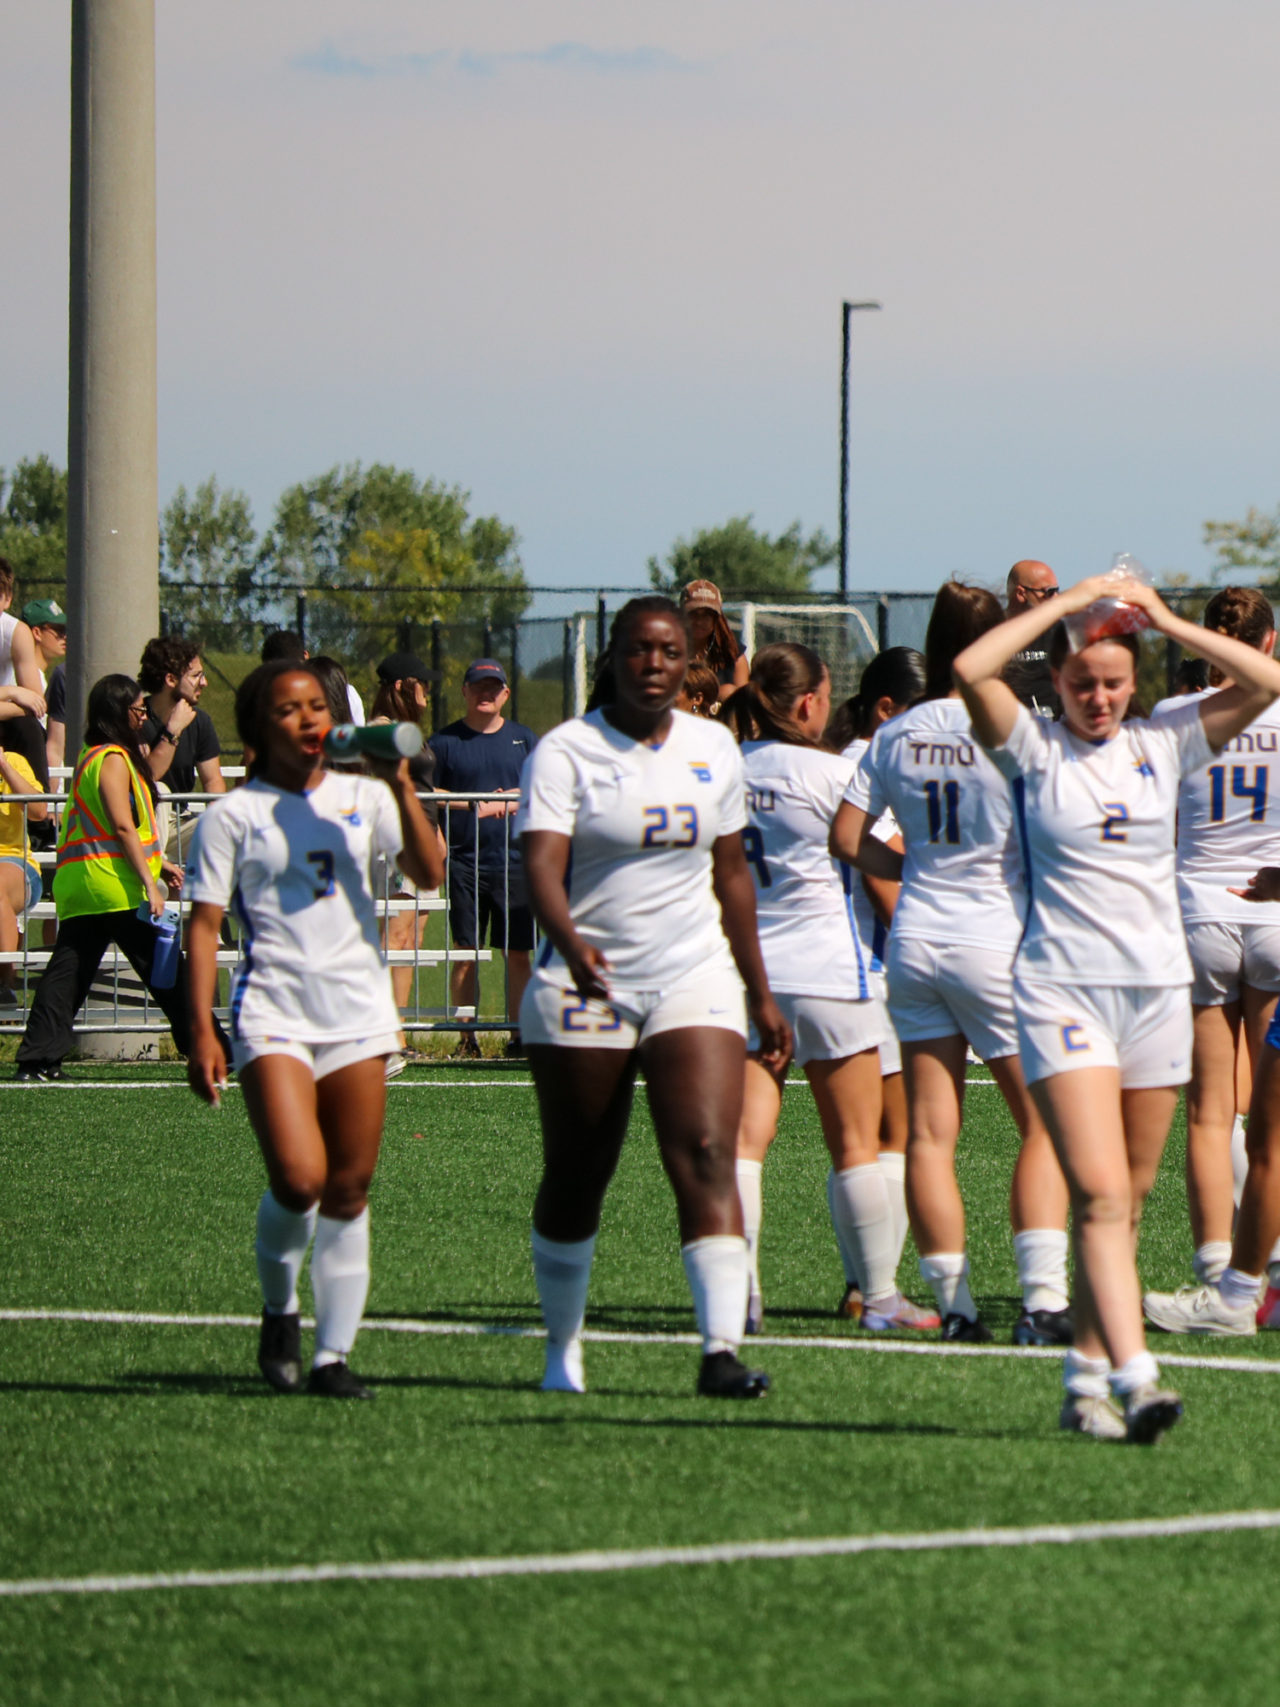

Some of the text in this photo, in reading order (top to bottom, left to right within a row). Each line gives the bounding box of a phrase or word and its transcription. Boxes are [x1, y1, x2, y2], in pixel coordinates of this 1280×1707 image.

[909, 743, 975, 767] TMU
[924, 779, 960, 844] 11
[1207, 764, 1269, 823] 14
[642, 804, 698, 848] 23
[1101, 801, 1128, 844] 2
[306, 850, 336, 900] 3
